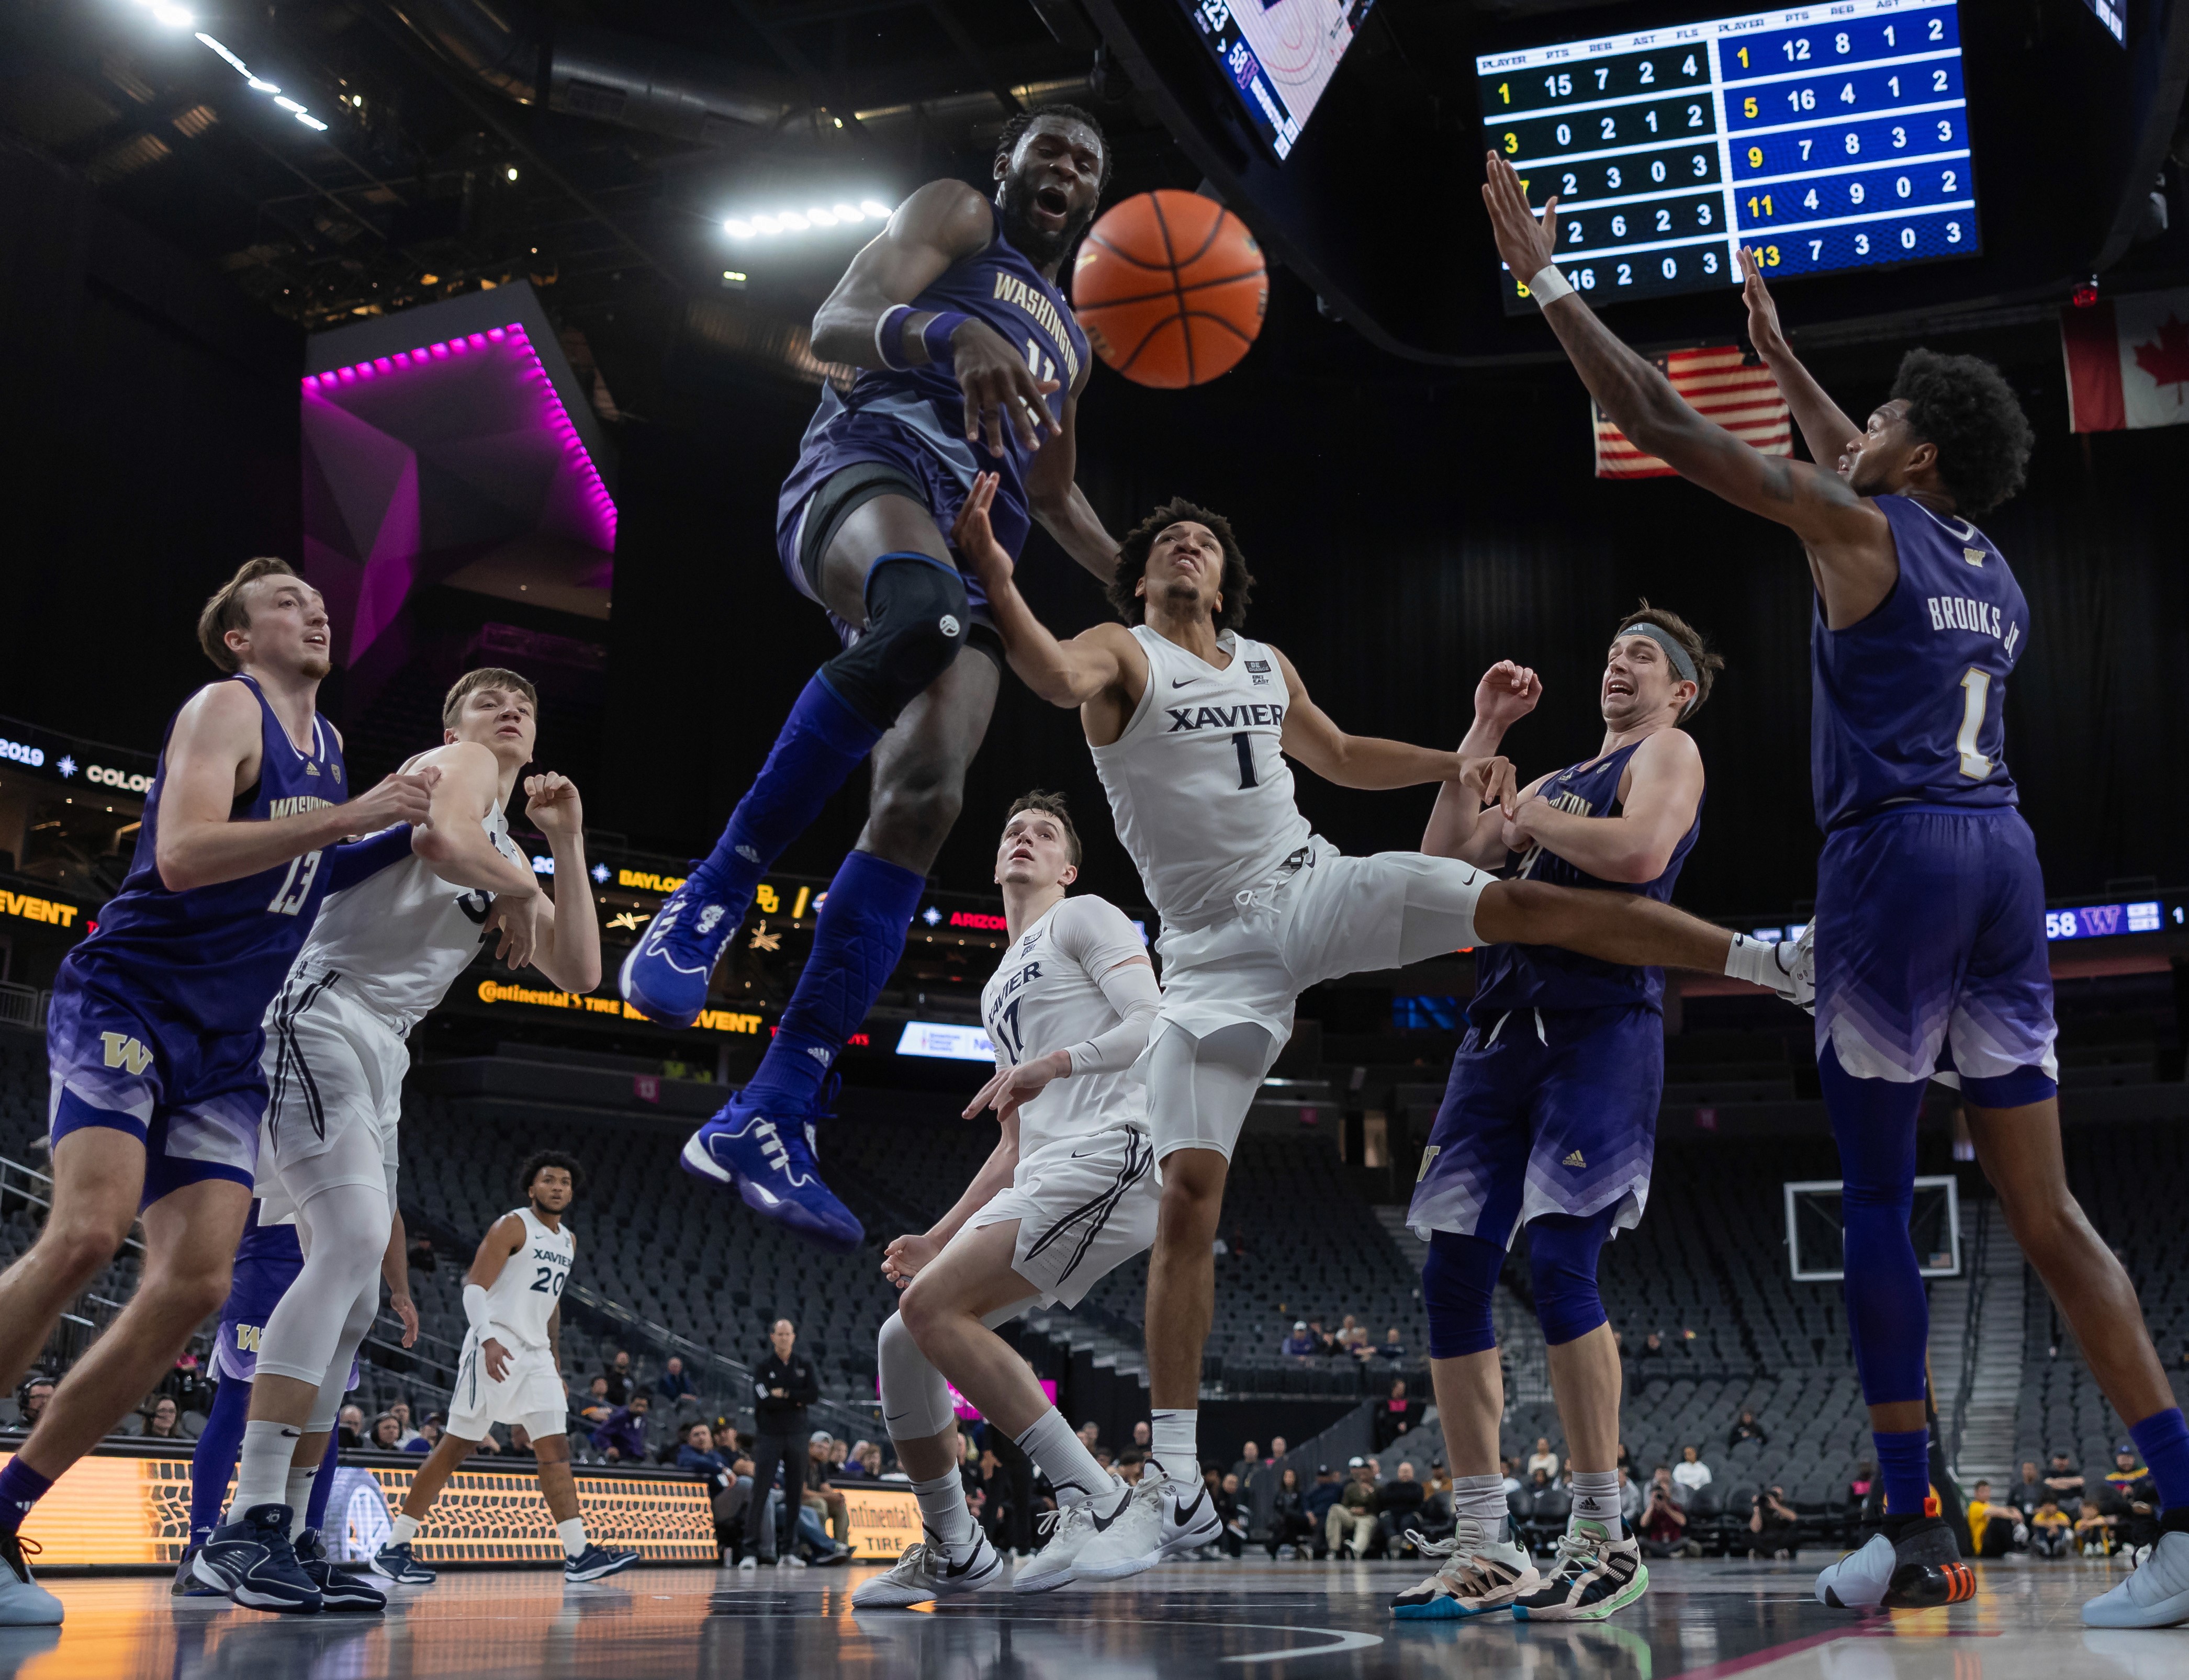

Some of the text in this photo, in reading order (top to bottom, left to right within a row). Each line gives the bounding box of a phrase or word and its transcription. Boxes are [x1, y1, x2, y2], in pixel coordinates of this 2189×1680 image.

[1719, 19, 1764, 32] PLAYER
[1786, 12, 1809, 22] PTS
[1831, 5, 1854, 15] REB
[1229, 42, 1248, 74] 58
[1483, 29, 1699, 69] PLAYER PTS REB AST FLS
[1737, 19, 1943, 68] 1 12 8 1 2
[1498, 55, 1698, 104] 1 15 7 2 4
[1744, 70, 1948, 118] 5 16 4 1 2
[1504, 105, 1702, 154] 3 0 2 1 2
[1748, 120, 1952, 168] 9 7 8 3 3
[1563, 173, 1577, 195] 2
[1607, 167, 1621, 188] 3
[1652, 161, 1666, 182] 0
[1693, 155, 1707, 176] 3
[1747, 170, 1957, 218] 11 4 9 0 2
[1568, 205, 1712, 243] 2 6 2 3
[1753, 222, 1961, 268] 13 7 3 0 3
[1568, 269, 1595, 291] 16
[1617, 264, 1632, 285] 2
[1663, 258, 1677, 279] 0
[1703, 253, 1717, 274] 3
[994, 272, 1079, 392] WASHINGTON
[1928, 596, 2001, 639] BROOKS
[1165, 704, 1284, 732] XAVIER
[1957, 667, 1993, 781] 1
[0, 738, 44, 766] 2019
[1231, 731, 1259, 791] 1
[267, 850, 323, 916] 13
[2046, 911, 2077, 938] 58
[478, 980, 569, 1008] Continental
[584, 997, 621, 1014] TIRE
[989, 962, 1044, 1026] XAVIER
[996, 994, 1025, 1066] 17
[100, 1031, 154, 1075] W
[530, 1267, 565, 1296] 20
[866, 1537, 904, 1551] TIRE
